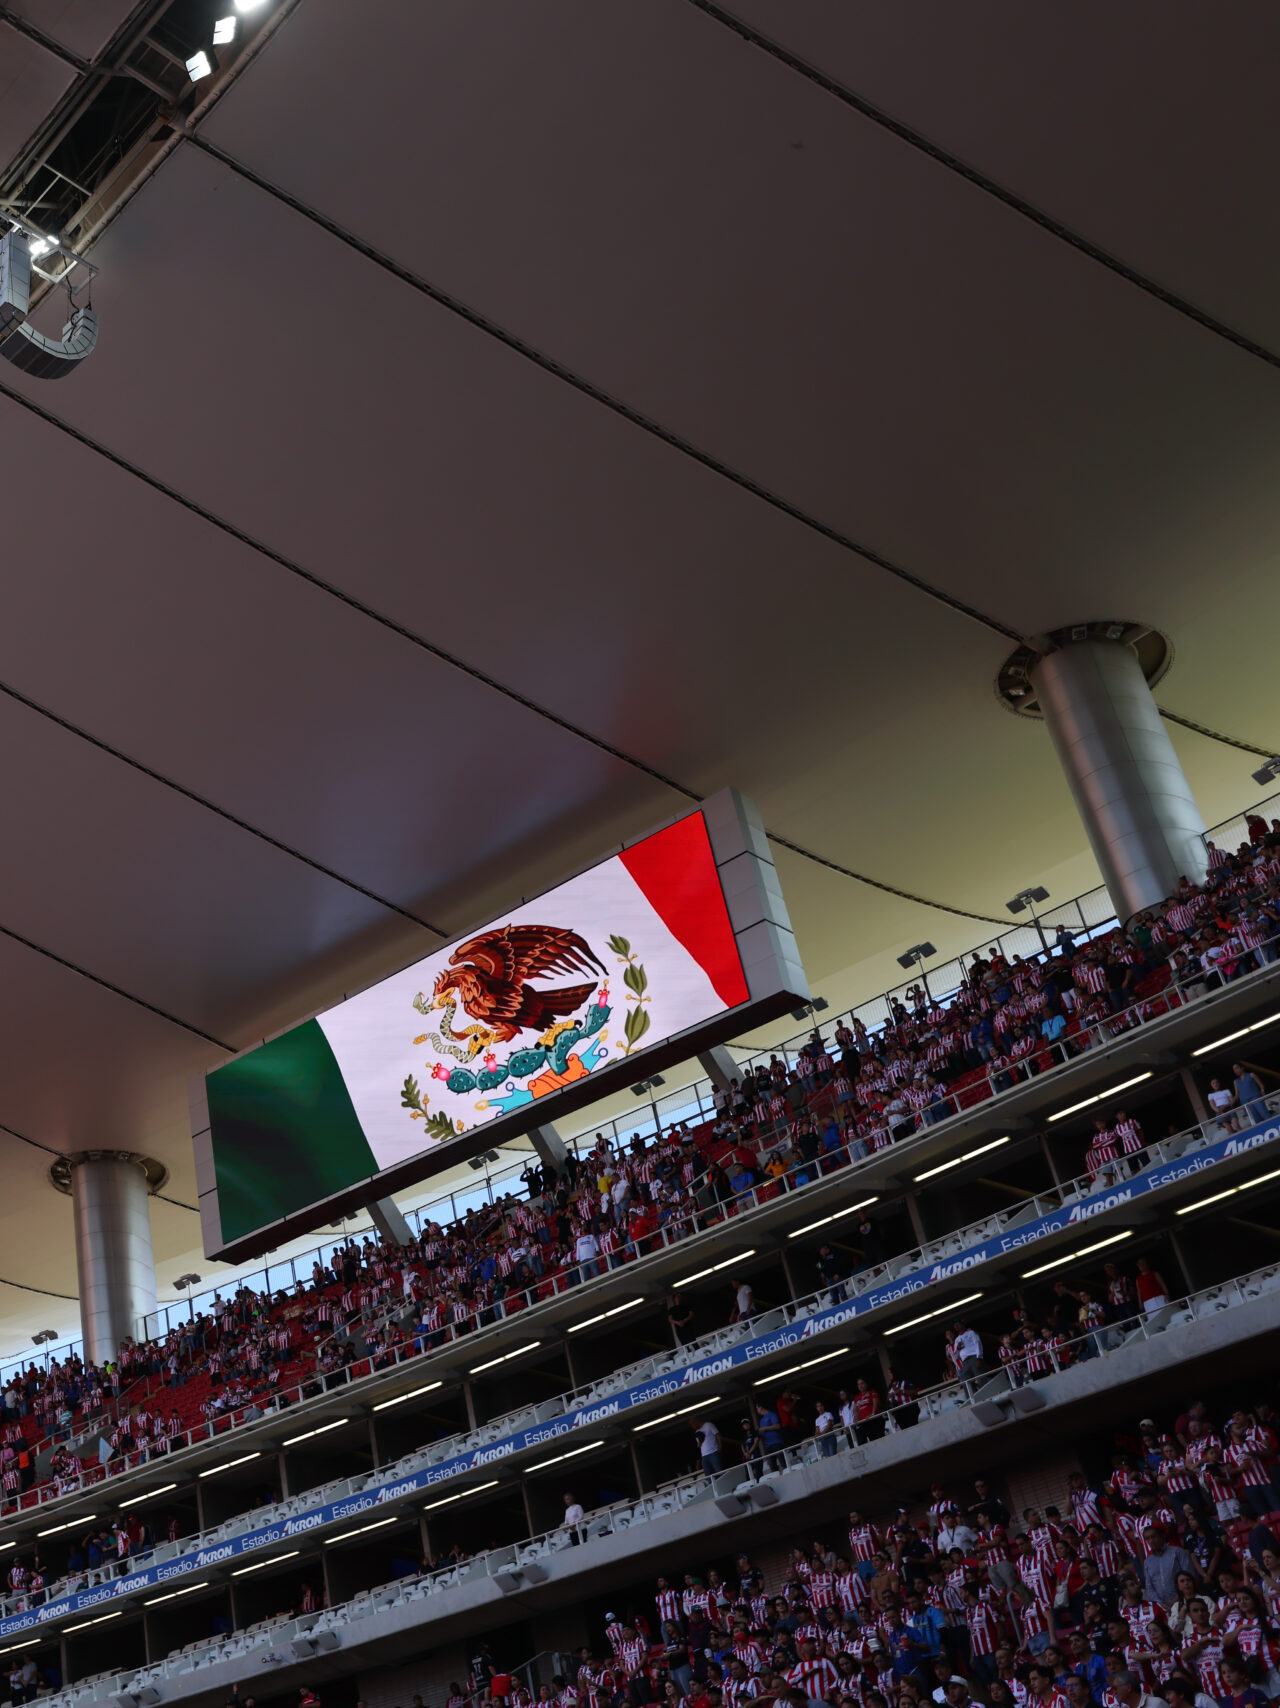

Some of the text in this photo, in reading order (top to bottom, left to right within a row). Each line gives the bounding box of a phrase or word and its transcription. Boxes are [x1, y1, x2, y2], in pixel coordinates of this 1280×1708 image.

[1147, 1125, 1280, 1187] Estadio AKRO
[1000, 1189, 1131, 1253] Estadio AKRON
[868, 1250, 985, 1308] Estadio AKRON
[745, 1306, 855, 1357] Estadio AKRON
[629, 1356, 732, 1404] Estadio AKRON
[524, 1401, 618, 1445] Estadio AKRON
[426, 1442, 513, 1482] Estadio AKRON
[332, 1480, 416, 1519] Estadio AKRON
[241, 1513, 322, 1550] Estadio AKRON
[156, 1545, 232, 1580] Estadio AKRON
[77, 1574, 148, 1608] Estadio AKRON
[0, 1602, 69, 1633] Estadio AKRON
